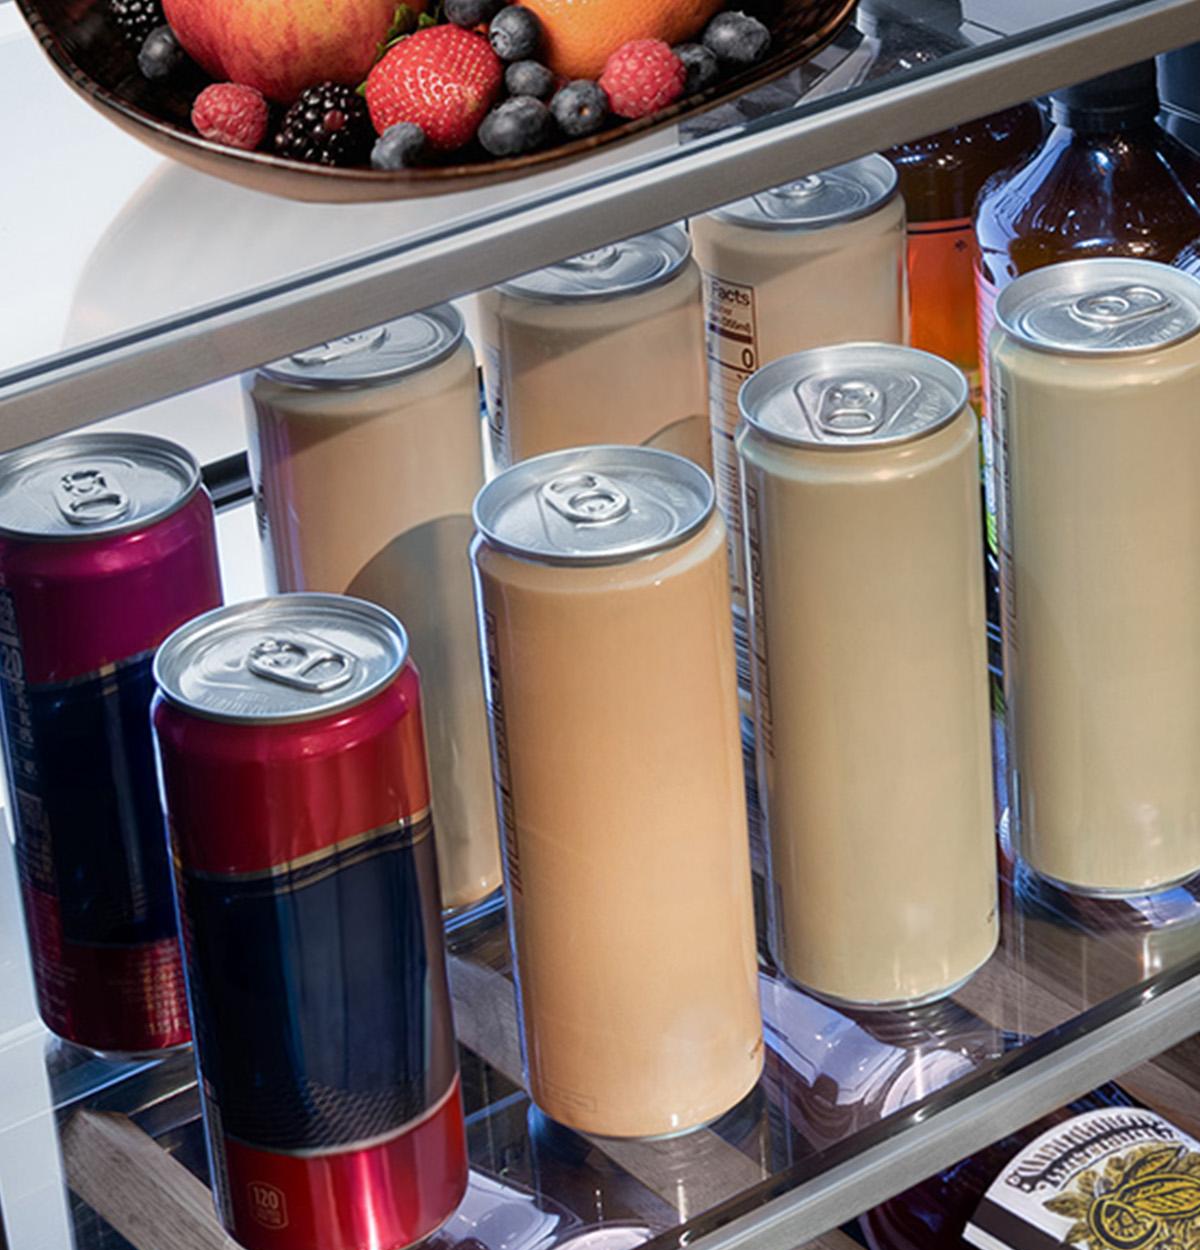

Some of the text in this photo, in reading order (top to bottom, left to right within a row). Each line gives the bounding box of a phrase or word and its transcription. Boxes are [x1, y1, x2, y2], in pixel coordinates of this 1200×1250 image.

[711, 281, 750, 306] Facts
[742, 348, 754, 369] 0
[253, 1186, 279, 1209] 120
